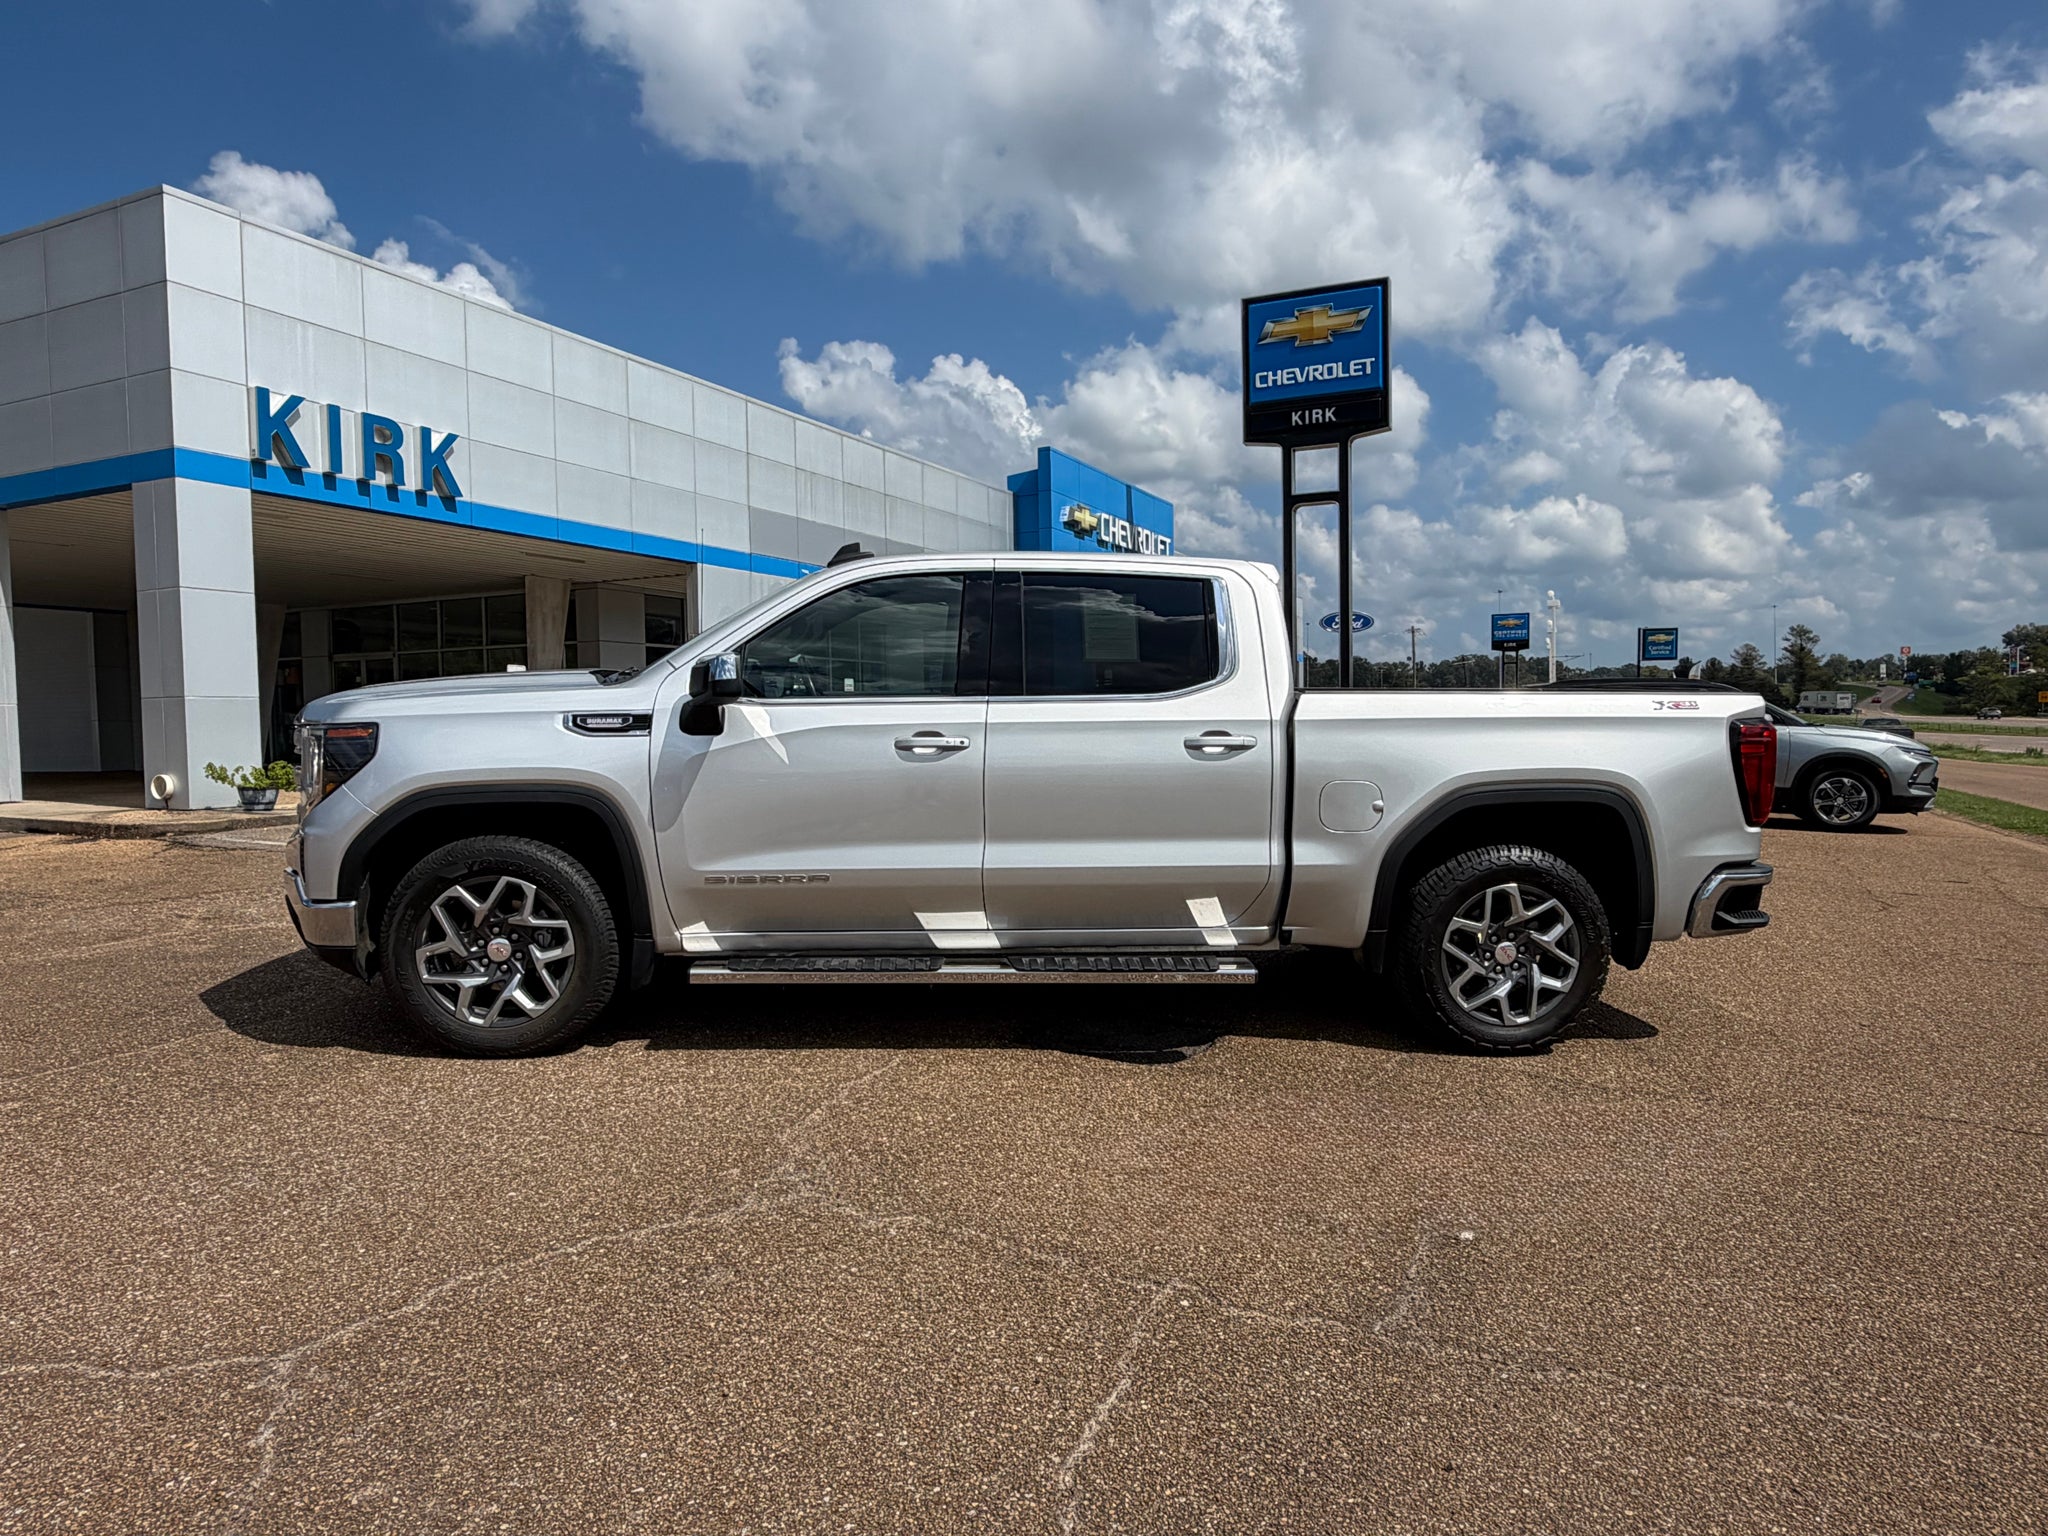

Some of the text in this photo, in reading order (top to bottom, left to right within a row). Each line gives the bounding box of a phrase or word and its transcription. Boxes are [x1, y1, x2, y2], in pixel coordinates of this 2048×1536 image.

[1255, 357, 1375, 388] CHEVROLET
[1291, 407, 1336, 426] KIRK
[251, 385, 463, 498] KIRK
[1100, 513, 1171, 556] CHEVROLET
[703, 873, 830, 884] SIERRA
